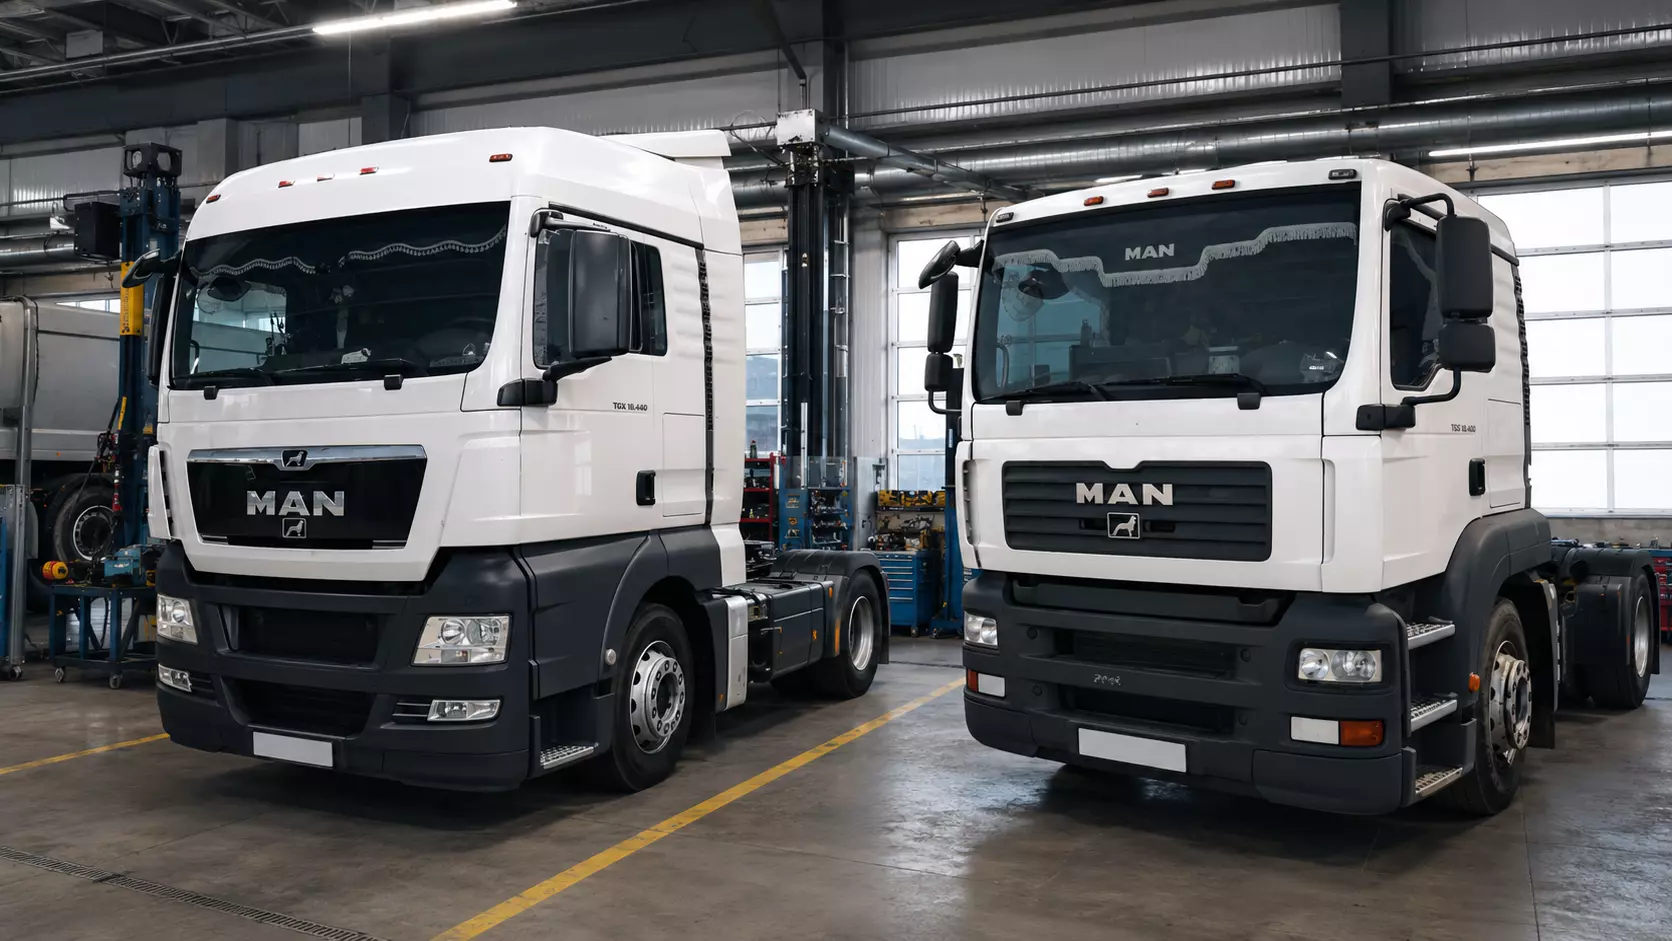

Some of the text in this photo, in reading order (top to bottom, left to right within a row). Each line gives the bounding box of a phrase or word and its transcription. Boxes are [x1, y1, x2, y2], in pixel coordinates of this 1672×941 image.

[1125, 243, 1175, 261] MAN
[613, 402, 626, 410] TGX
[246, 490, 345, 516] MAN
[1076, 482, 1173, 506] MAN
